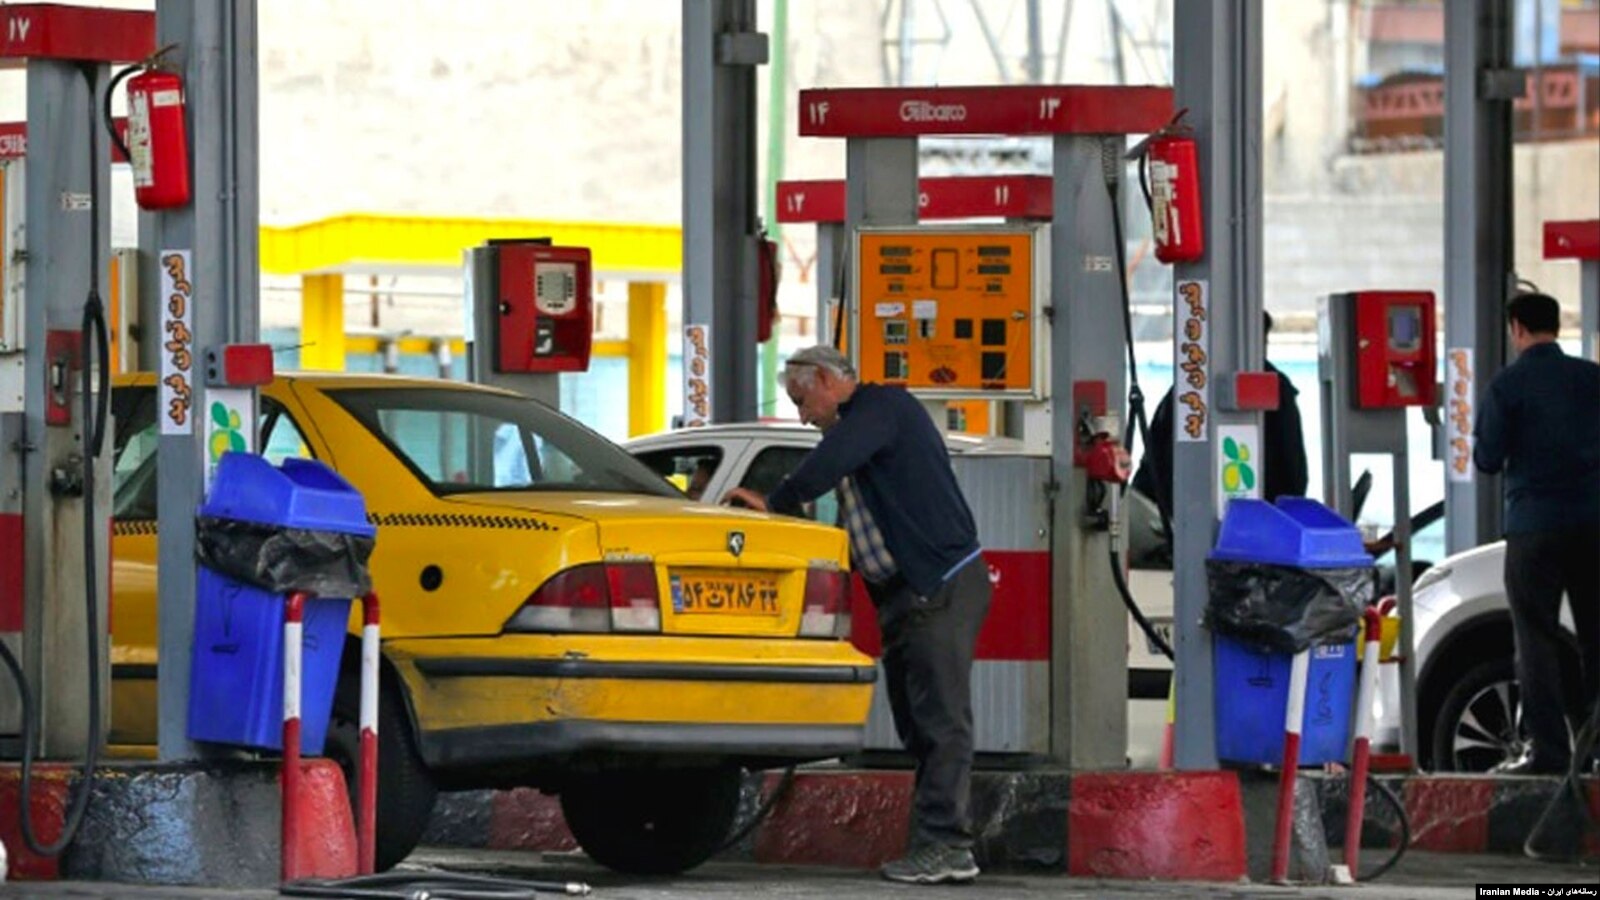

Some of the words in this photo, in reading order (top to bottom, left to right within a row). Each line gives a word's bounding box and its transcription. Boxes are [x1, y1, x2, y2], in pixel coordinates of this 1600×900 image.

[9, 17, 31, 42] ۱۷
[809, 102, 830, 125] ۱۴
[899, 100, 967, 121] Gilbarco
[994, 185, 1010, 207] ۱۱
[162, 253, 192, 318] قدرت
[1179, 282, 1206, 341] قدرت
[165, 319, 192, 371] توان
[1181, 342, 1207, 390] توان
[163, 373, 192, 426] خرید
